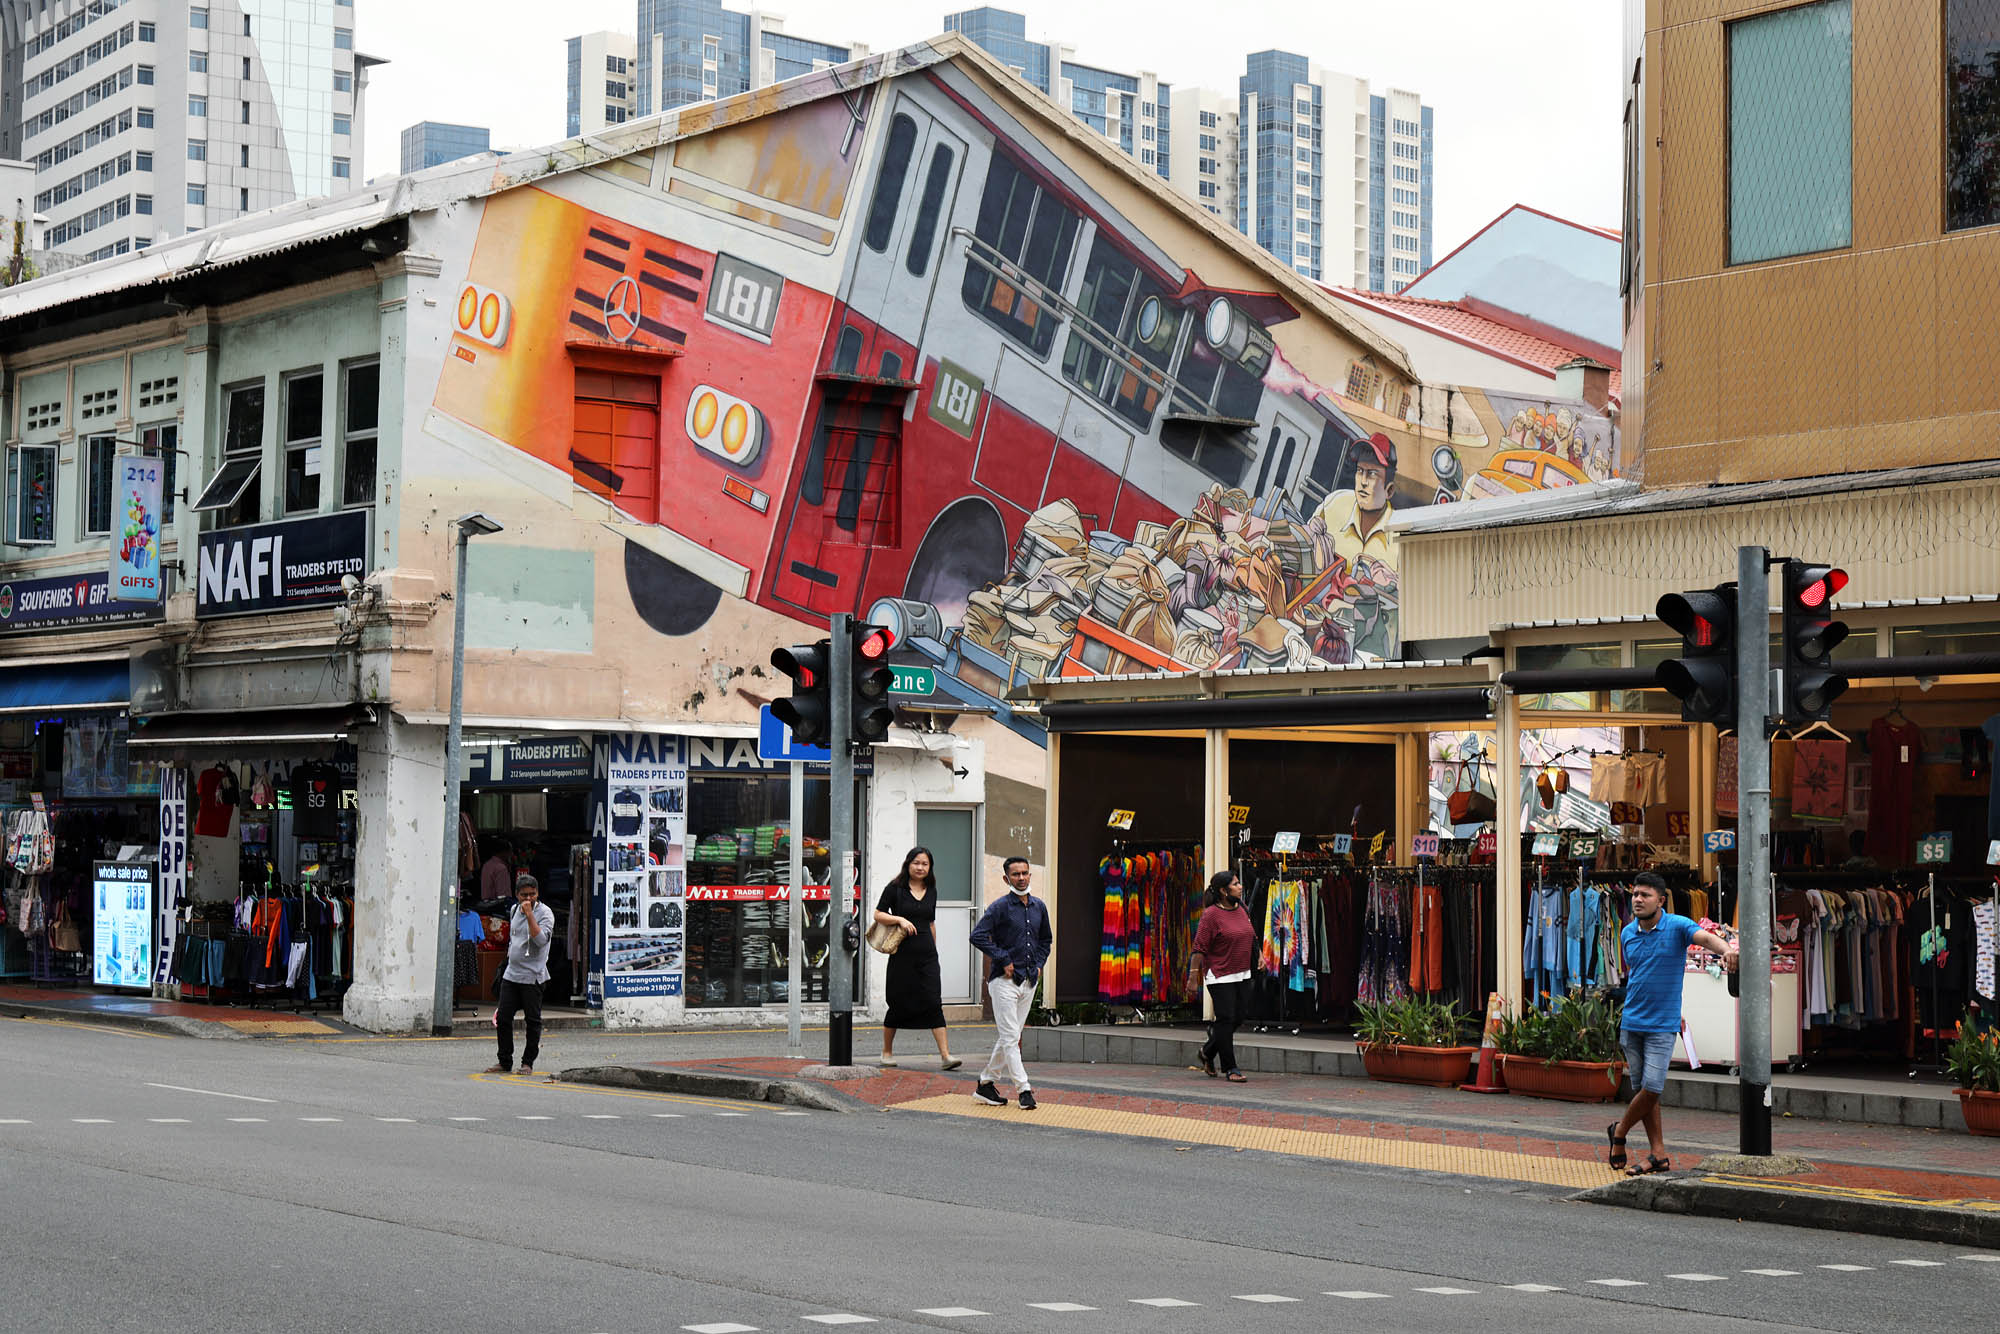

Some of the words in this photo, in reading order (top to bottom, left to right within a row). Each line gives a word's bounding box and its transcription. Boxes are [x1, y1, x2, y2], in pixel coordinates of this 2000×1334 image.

[716, 269, 773, 330] 181
[937, 372, 978, 426] 181
[127, 467, 156, 482] 214
[200, 535, 283, 605] NAFI
[286, 562, 325, 579] TRADERS
[327, 560, 344, 575] PTE
[345, 557, 363, 573] LTD
[120, 575, 155, 588] GIFTS
[325, 584, 342, 594] Singapo
[19, 587, 73, 611] SOUVENIRS
[77, 585, 86, 606] N
[89, 583, 117, 605] GIFT
[893, 674, 925, 691] ane
[510, 745, 551, 760] TRADERS
[552, 745, 571, 759] PTE
[611, 732, 686, 764] NAFI
[690, 737, 774, 769] NA
[510, 770, 518, 778] 212
[519, 770, 540, 779] Serangoon
[541, 769, 552, 777] Road
[552, 768, 572, 779] Singapore
[611, 769, 650, 780] TRADERS
[652, 770, 668, 780] PTE
[669, 770, 686, 780] LTD
[308, 794, 326, 808] SG
[1228, 808, 1248, 822] $12
[1614, 803, 1639, 823] $5
[1239, 827, 1251, 844] $10
[1277, 834, 1297, 849] $5
[1707, 833, 1732, 850] $6
[1337, 837, 1348, 850] $7
[1414, 838, 1437, 852] $10
[1573, 840, 1595, 856] $5
[1923, 843, 1944, 860] $5
[99, 866, 116, 879] whole
[118, 866, 131, 879] sale
[132, 867, 148, 881] price
[686, 886, 728, 899] NAFI
[626, 976, 661, 985] Serangoon
[662, 975, 679, 983] Road
[616, 984, 650, 993] Singapore
